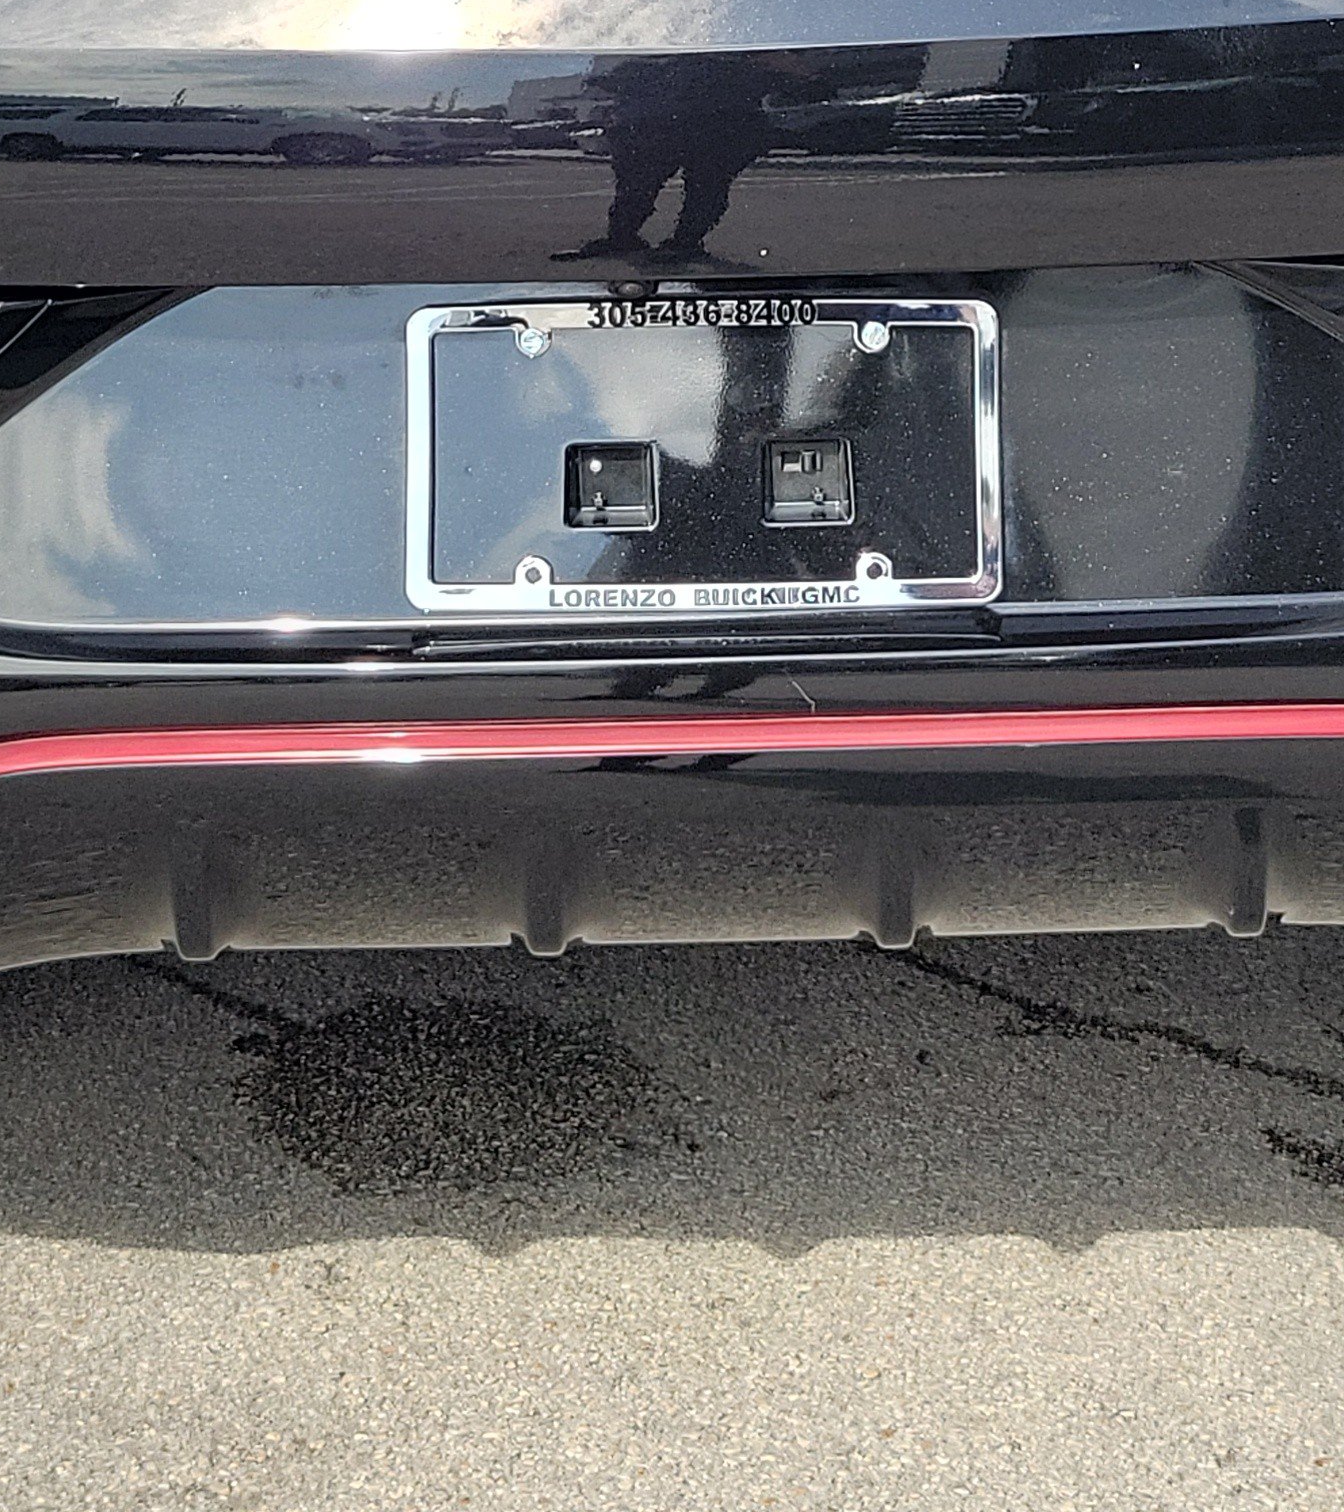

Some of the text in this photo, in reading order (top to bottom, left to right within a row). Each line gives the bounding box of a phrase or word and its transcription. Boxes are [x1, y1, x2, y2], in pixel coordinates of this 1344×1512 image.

[587, 300, 817, 327] 305-436-8400
[549, 585, 861, 609] LORENZO BUICK GMC
